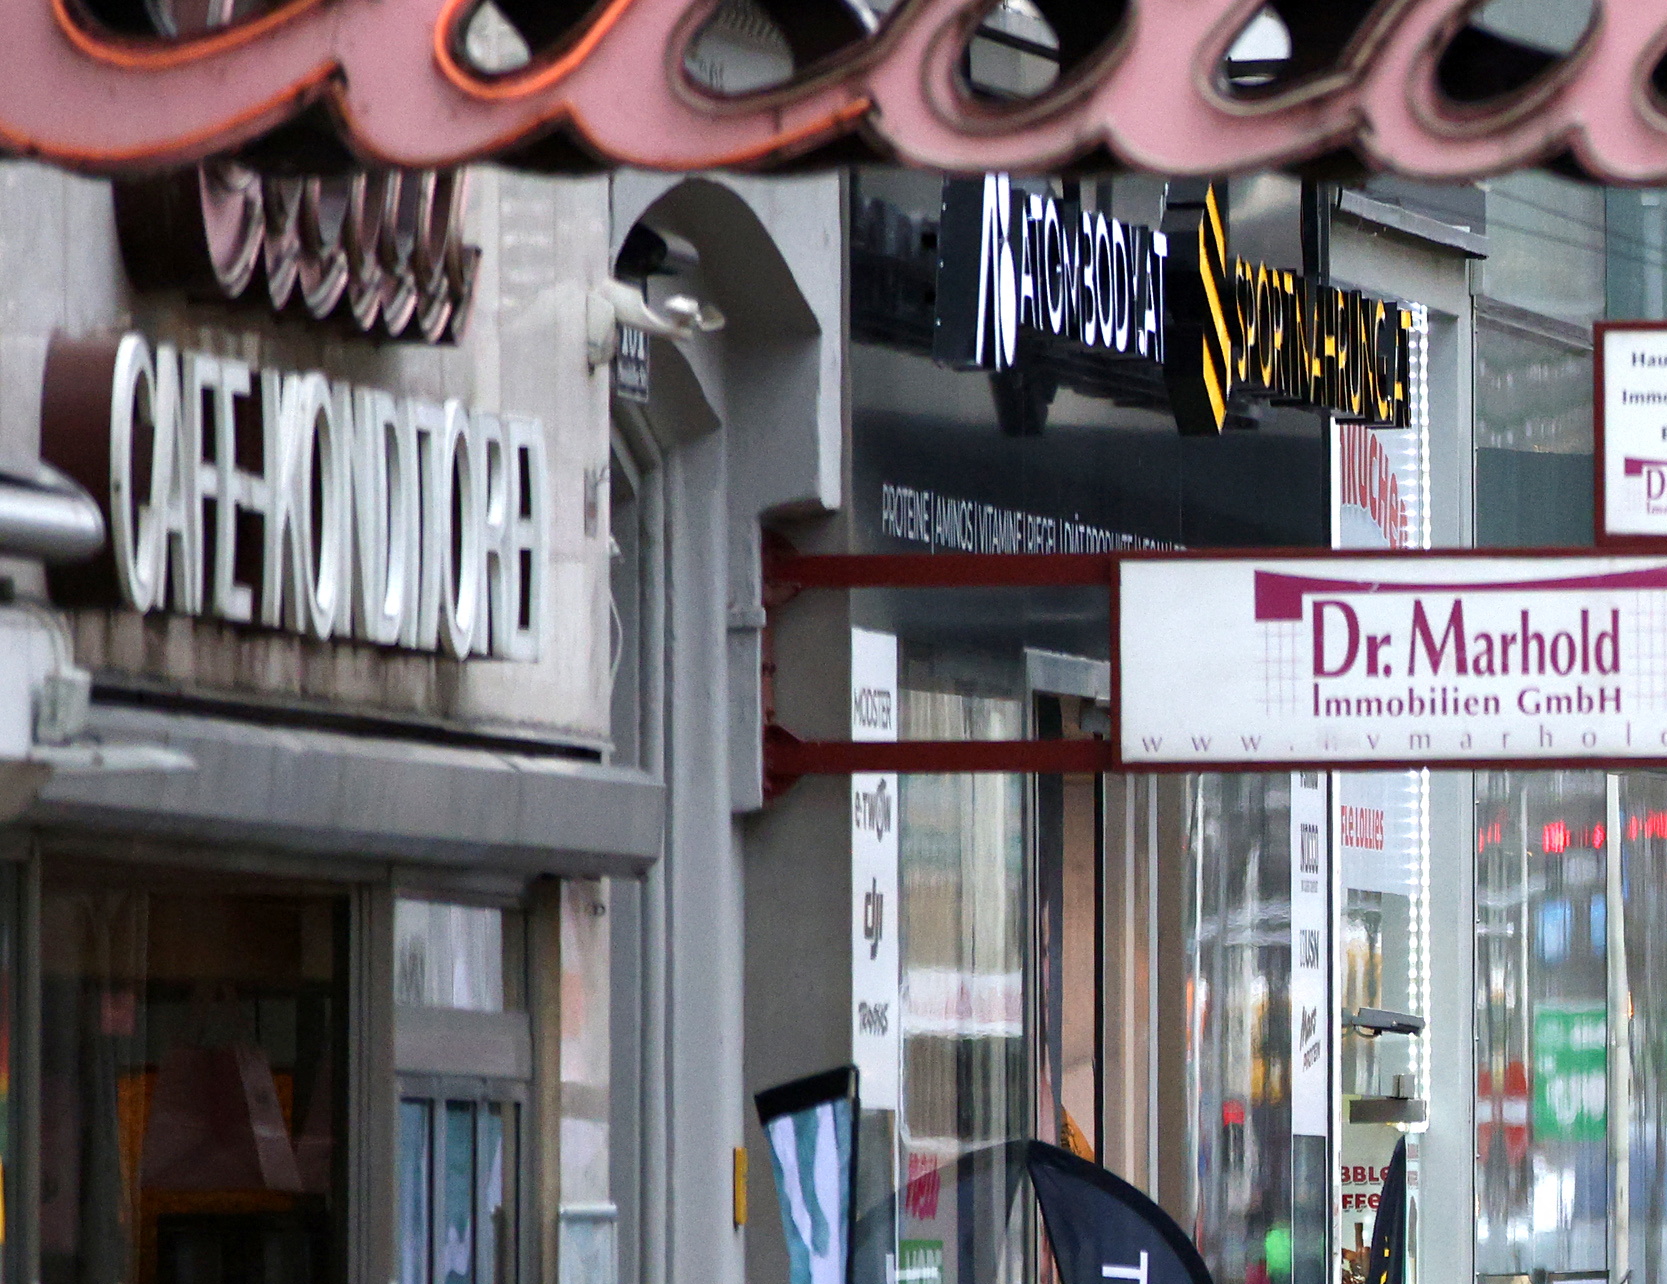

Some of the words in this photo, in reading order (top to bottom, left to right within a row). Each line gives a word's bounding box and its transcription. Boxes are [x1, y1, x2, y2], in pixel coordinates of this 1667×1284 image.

[1312, 600, 1392, 678] Dr.
[1407, 598, 1621, 677] Marhold
[1313, 683, 1500, 718] Immobilien
[1517, 686, 1622, 716] GmbH
